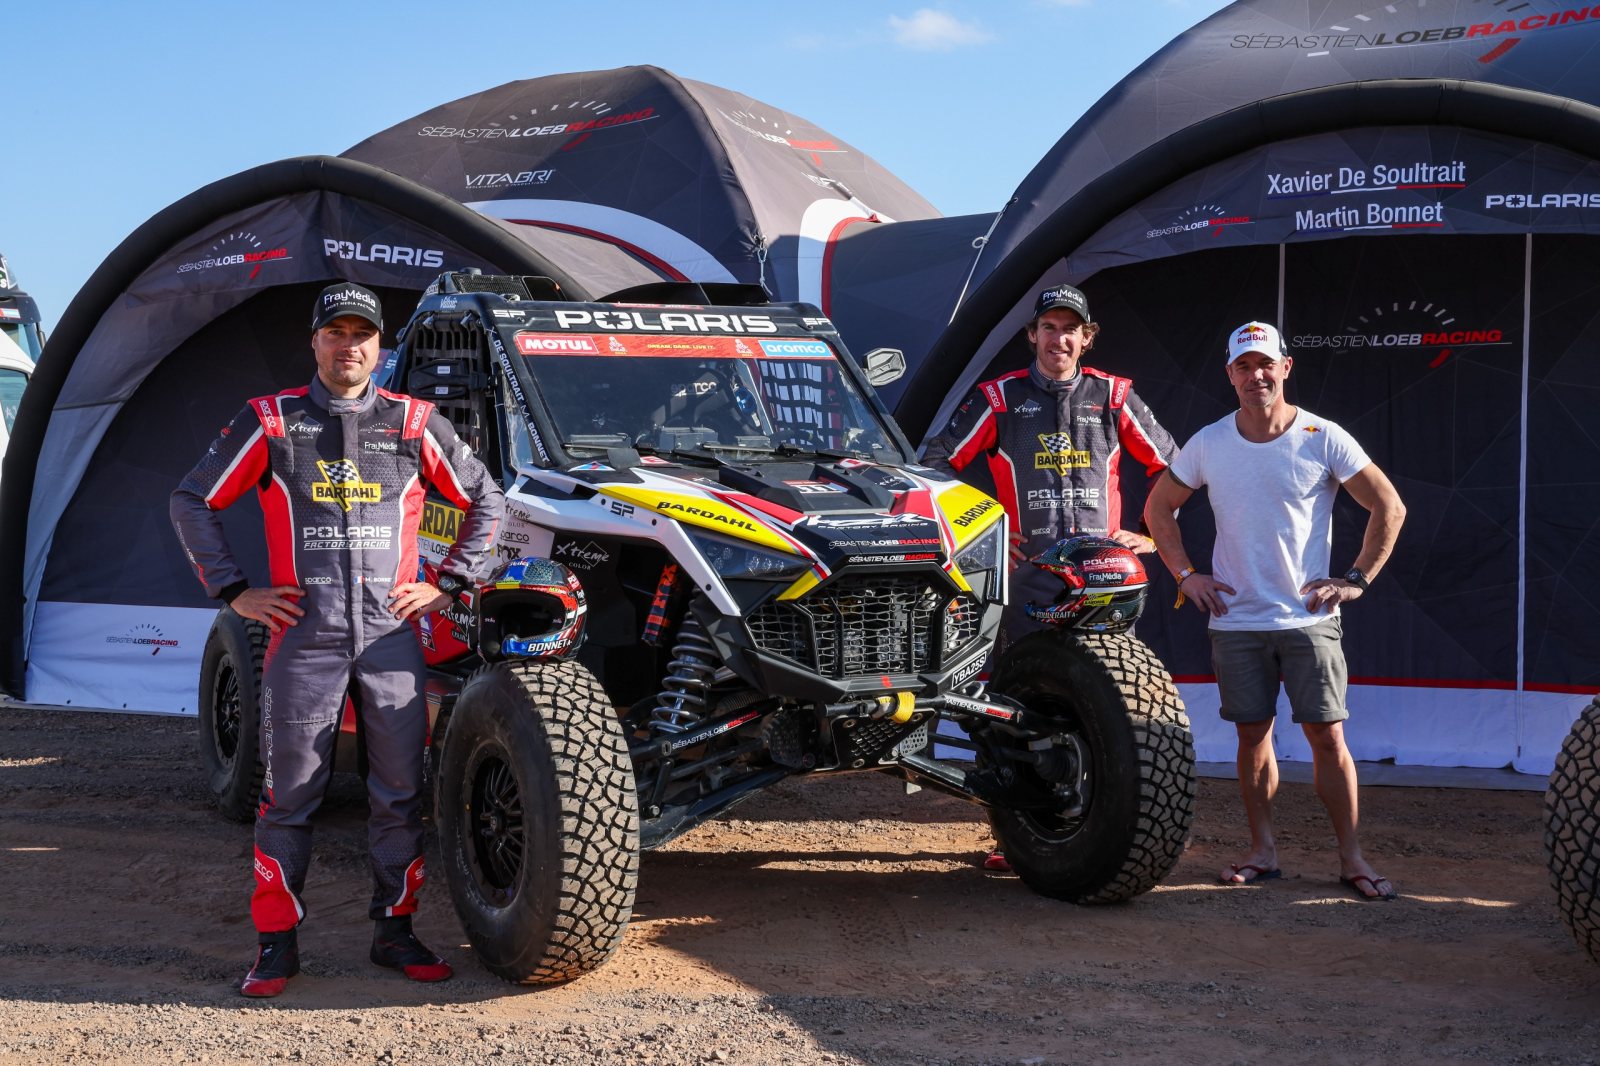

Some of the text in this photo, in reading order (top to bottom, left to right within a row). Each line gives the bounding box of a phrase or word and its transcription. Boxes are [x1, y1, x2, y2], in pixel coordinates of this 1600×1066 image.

[465, 169, 554, 186] VITABRI
[1267, 160, 1467, 195] Xavier De Soultrait
[1485, 194, 1600, 209] POLARIS
[1295, 201, 1444, 231] Martin Bonnet
[323, 238, 444, 269] POLARIS
[324, 289, 377, 308] FrayMédia
[554, 310, 778, 334] POLARIS
[525, 339, 593, 351] MOTUL
[765, 344, 826, 354] aramco
[499, 353, 525, 402] SOULTRAIT
[527, 421, 551, 463] BONNET
[1037, 454, 1088, 466] BARDAHL
[315, 486, 378, 499] BARDAHL
[1027, 488, 1100, 501] POLARIS
[656, 501, 757, 533] BARDAHL
[303, 525, 392, 539] POLARIS
[303, 540, 391, 549] FACTORY RACING
[1082, 557, 1129, 567] POLARIS
[1088, 573, 1122, 582] FrayMédia
[527, 638, 567, 653] BONNET
[953, 656, 987, 685] YBA25S
